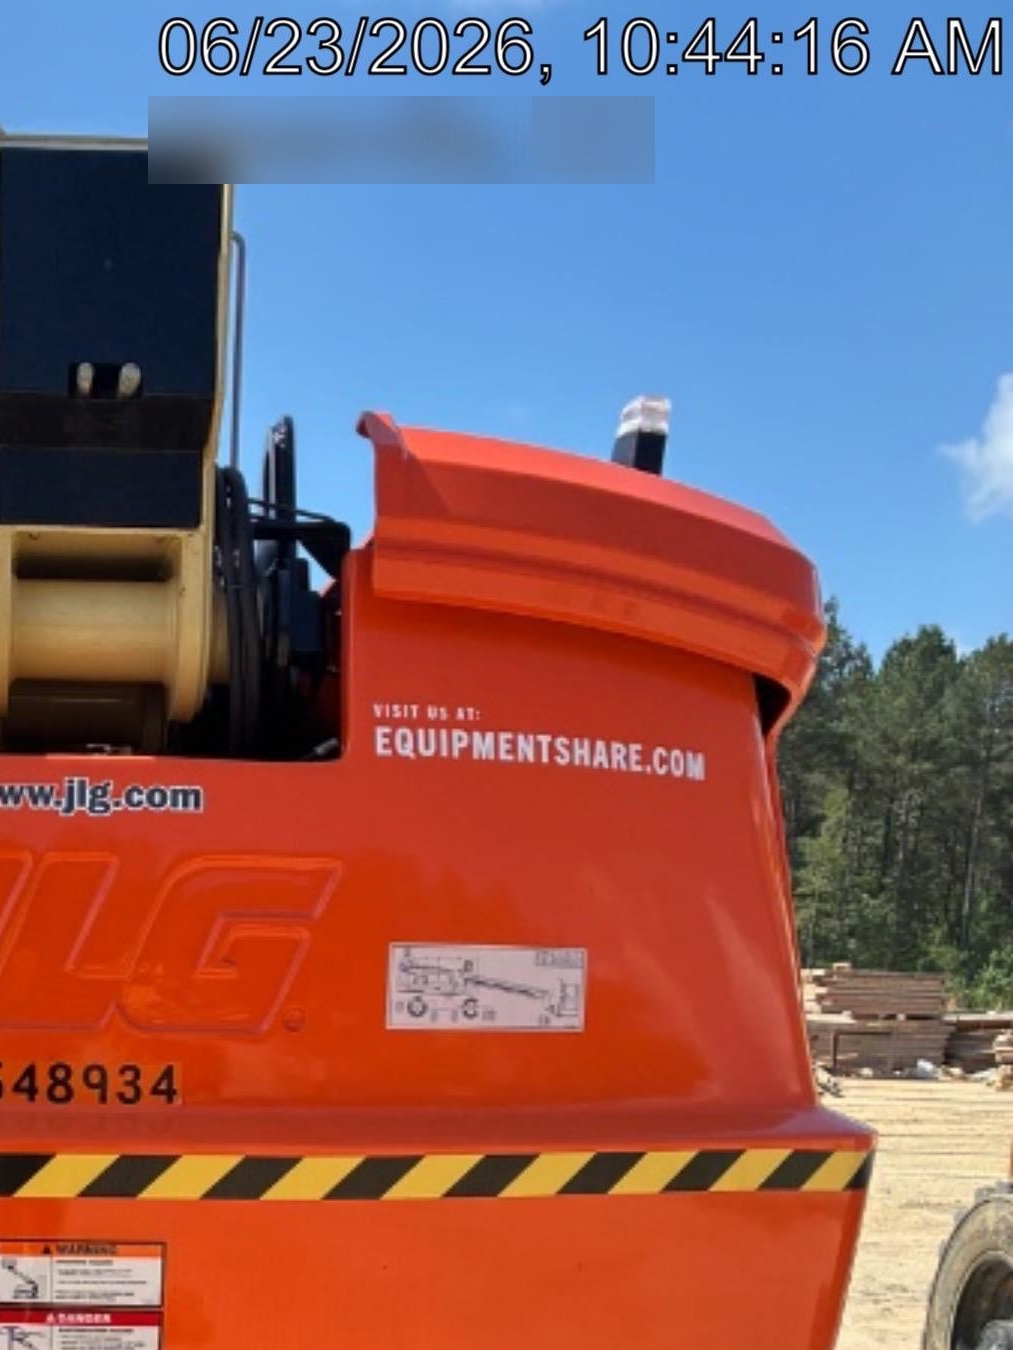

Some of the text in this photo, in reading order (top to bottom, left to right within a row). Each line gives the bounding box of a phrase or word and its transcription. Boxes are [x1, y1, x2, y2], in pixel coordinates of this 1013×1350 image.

[373, 703, 482, 721] VISIT US AT:
[374, 725, 706, 781] EQUIPMENTSHARE.COM
